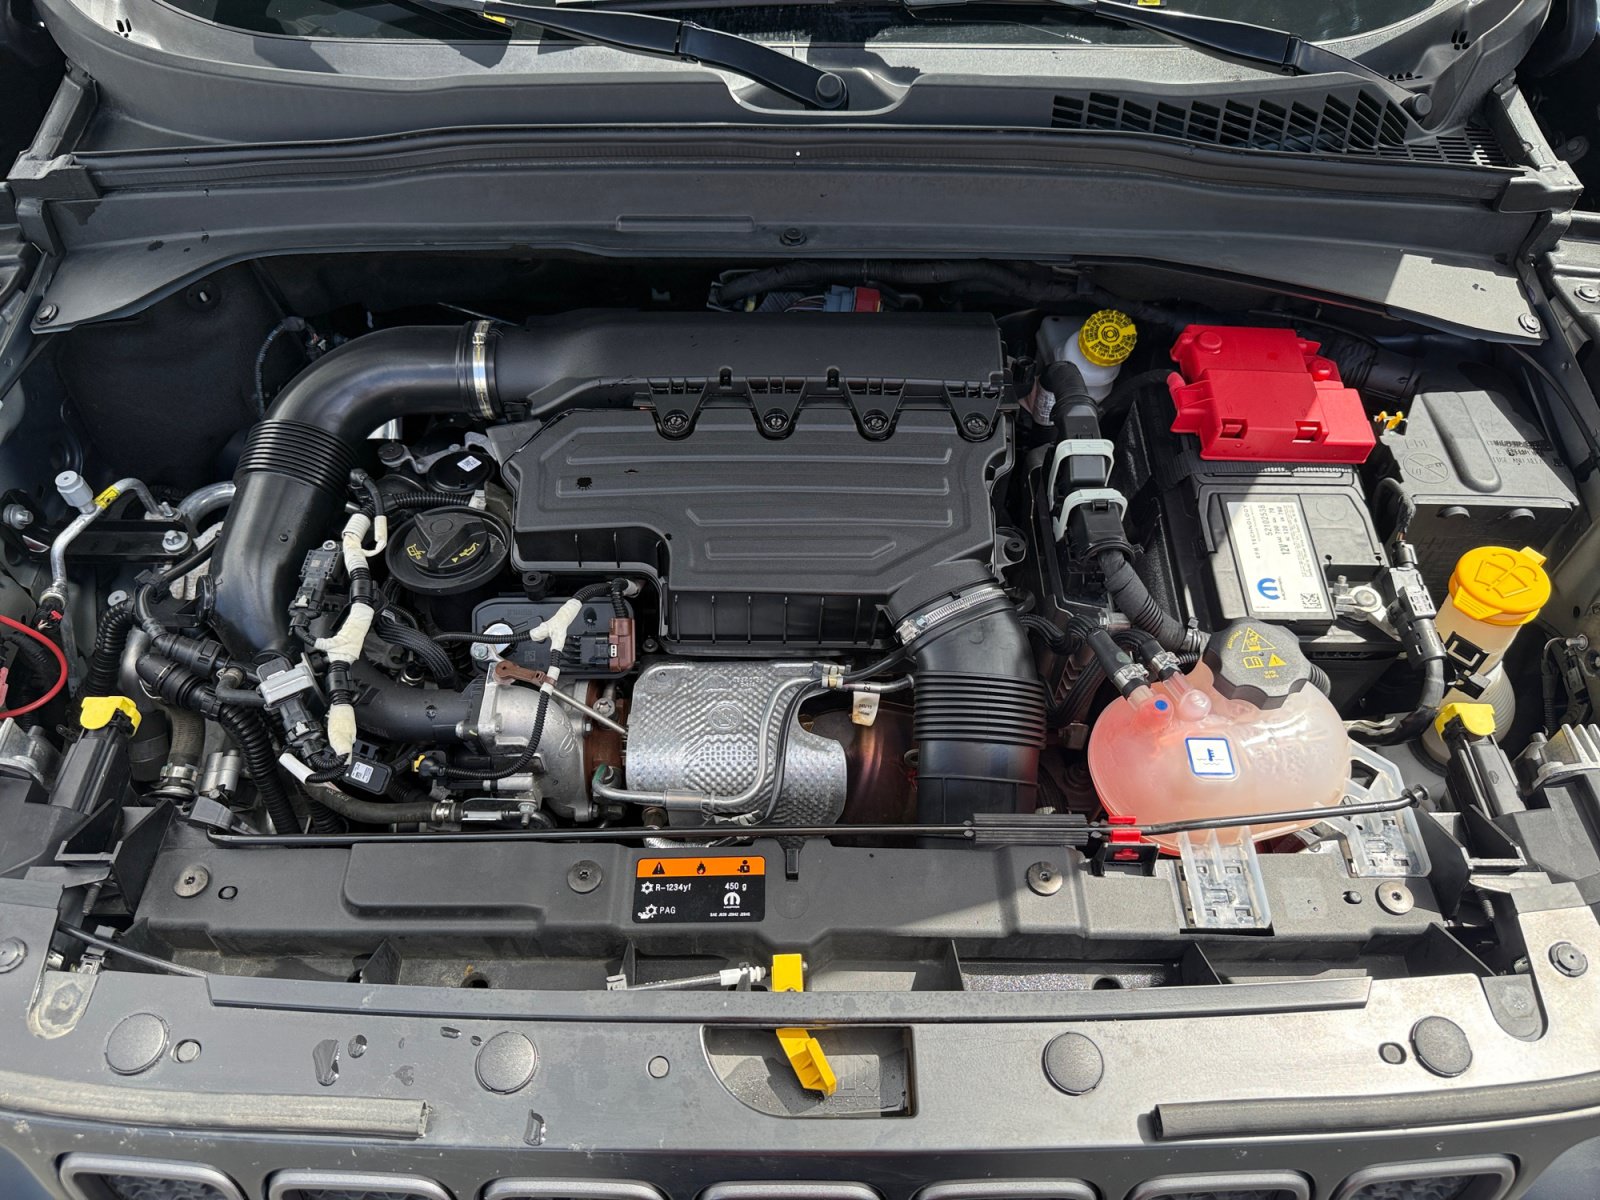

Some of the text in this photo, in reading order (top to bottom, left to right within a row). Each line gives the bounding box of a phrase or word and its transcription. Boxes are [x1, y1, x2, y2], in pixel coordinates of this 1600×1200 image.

[655, 883, 692, 893] R-1234yf
[724, 882, 747, 891] 450 g
[659, 906, 676, 914] PAG
